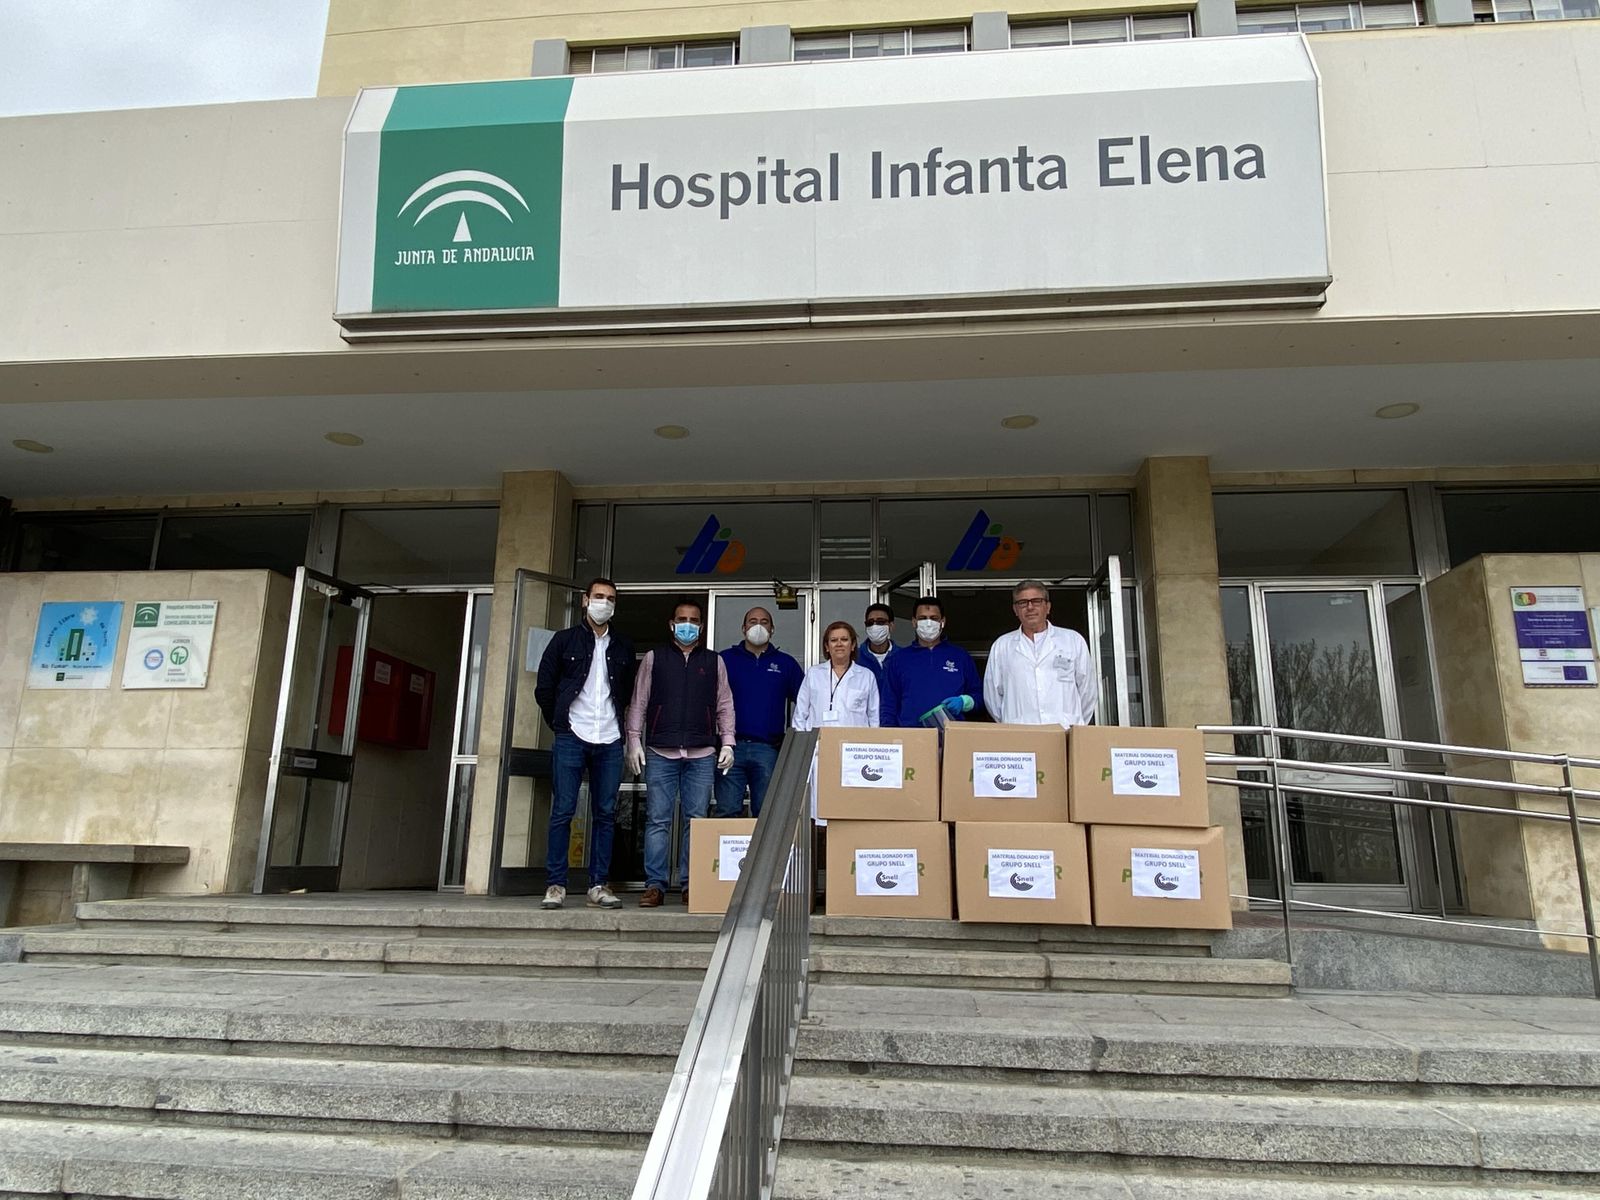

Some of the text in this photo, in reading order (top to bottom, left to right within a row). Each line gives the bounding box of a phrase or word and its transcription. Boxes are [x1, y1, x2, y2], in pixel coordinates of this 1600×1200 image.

[611, 135, 1266, 220] Hospital Infanta Elena
[394, 250, 436, 266] JUNTA
[442, 249, 458, 264] DE
